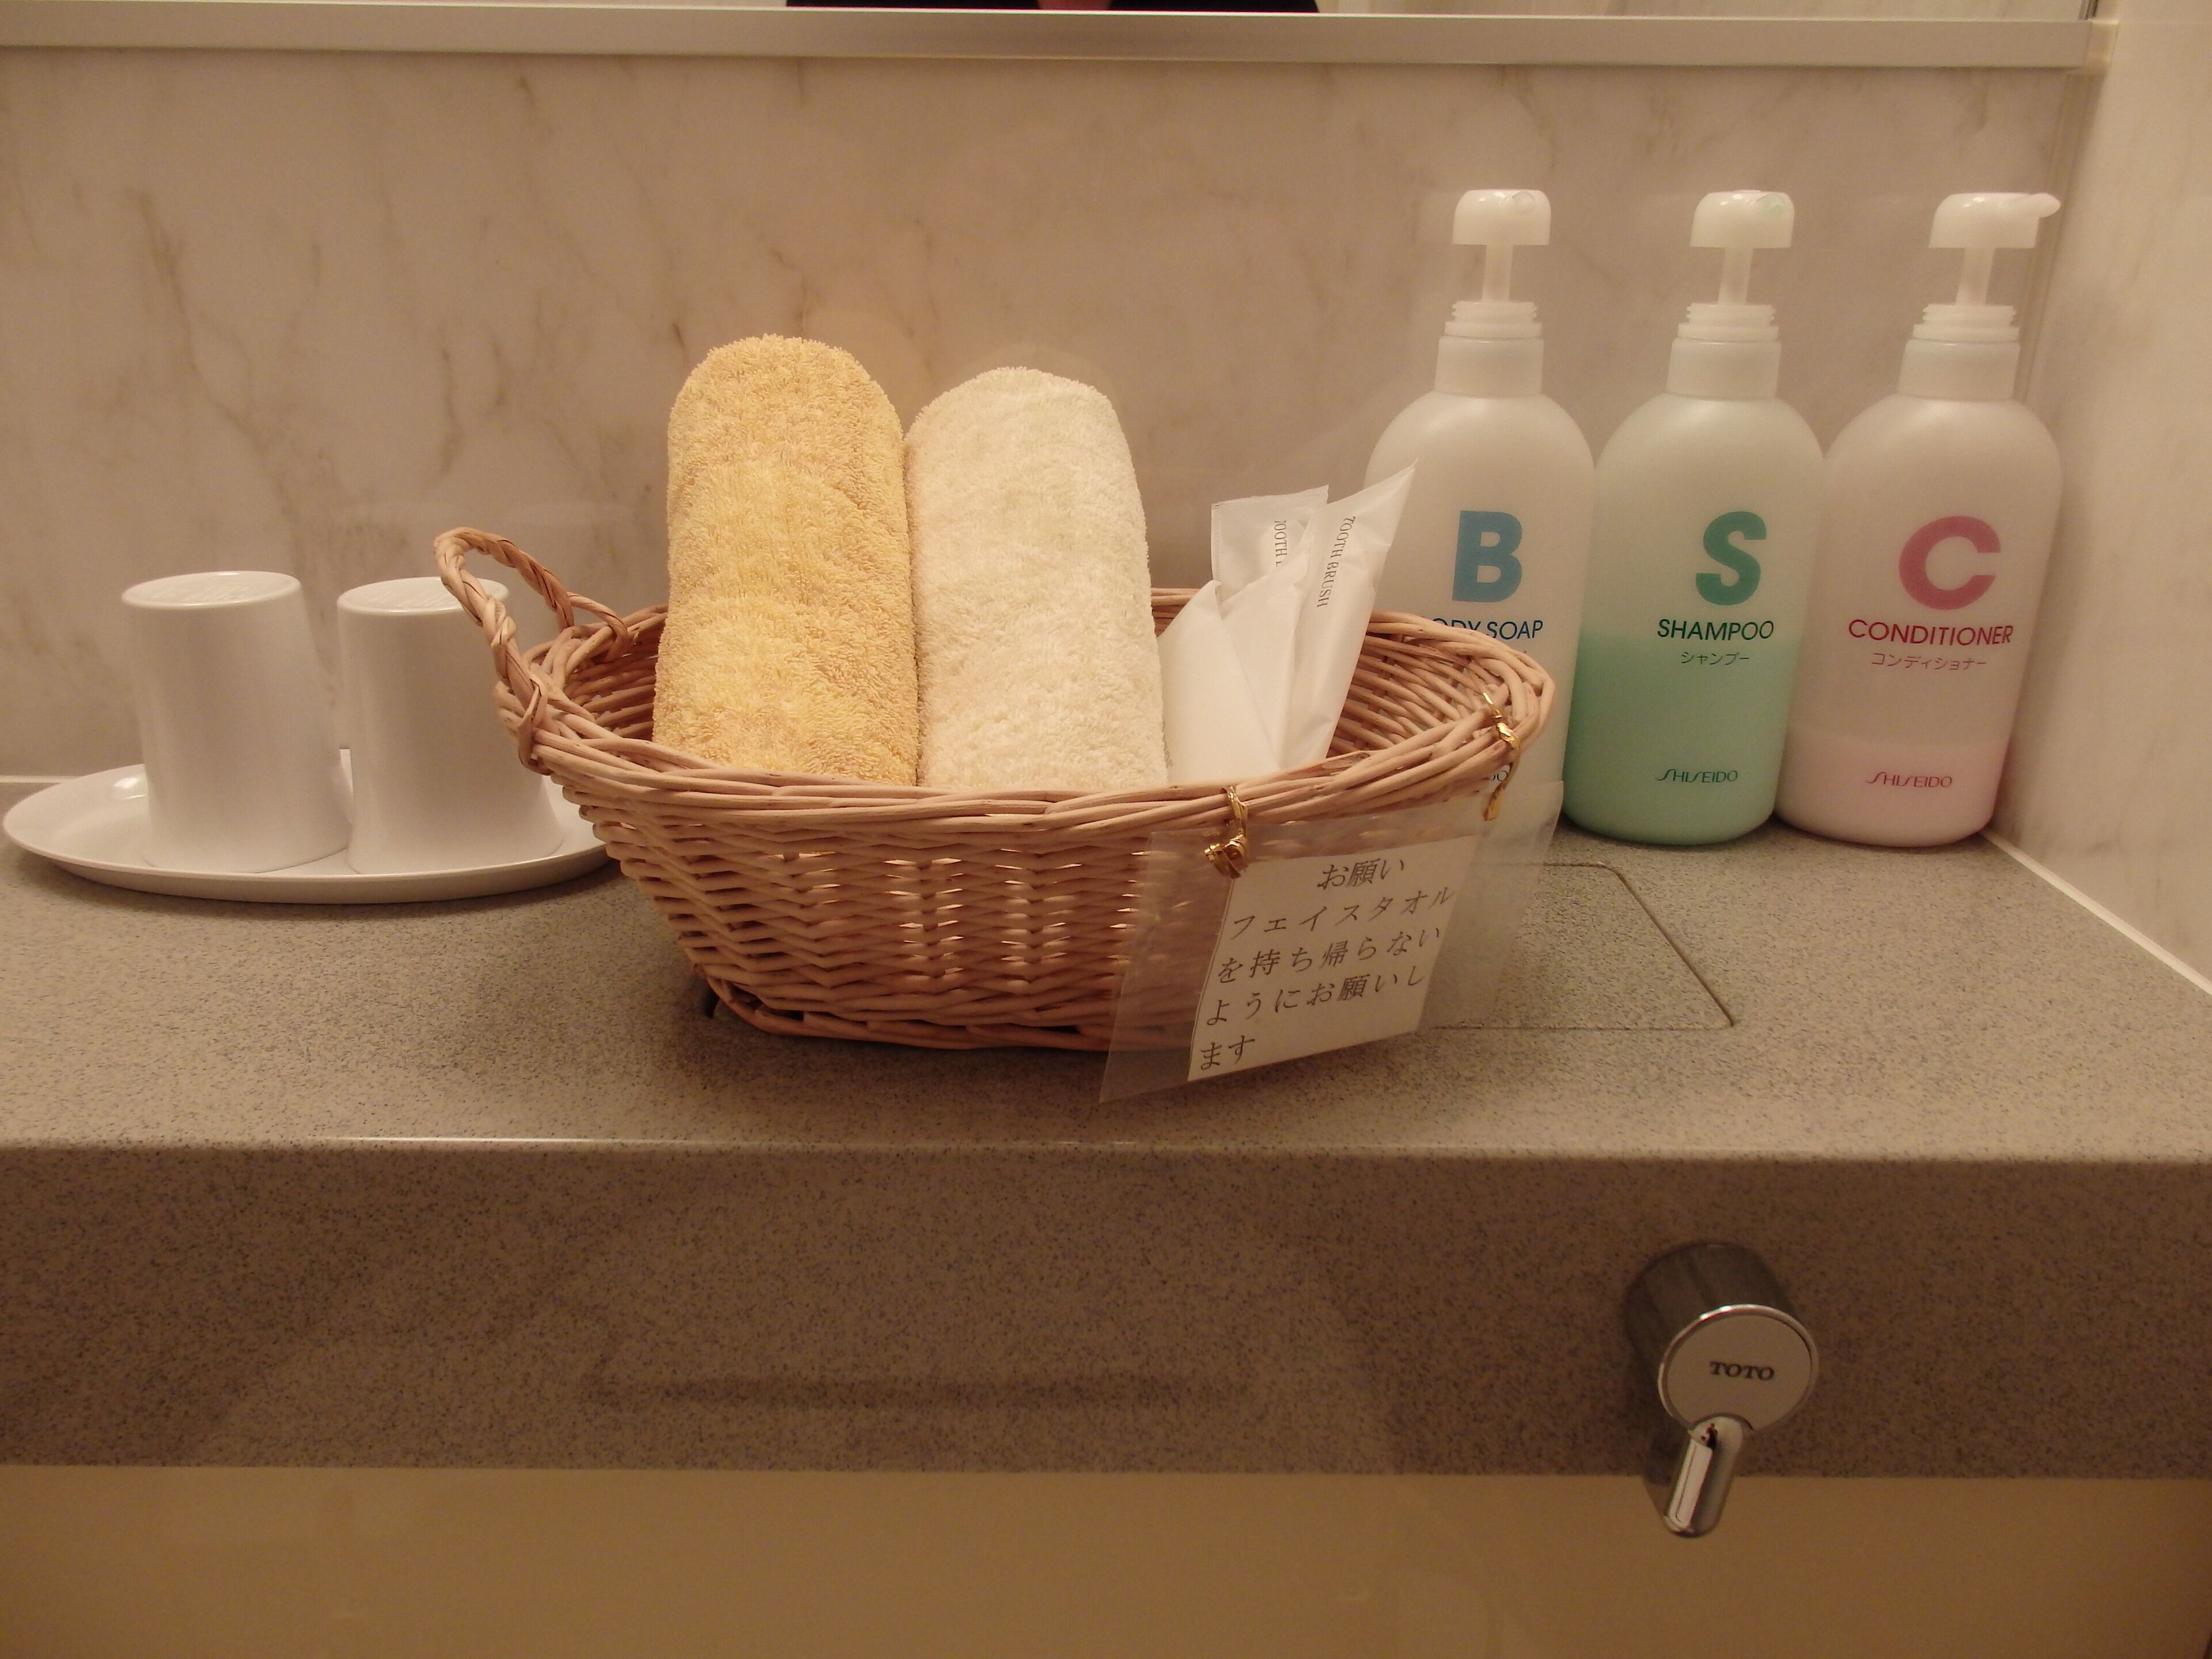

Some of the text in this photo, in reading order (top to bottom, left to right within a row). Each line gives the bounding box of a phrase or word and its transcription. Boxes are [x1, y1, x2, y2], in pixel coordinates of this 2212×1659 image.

[1317, 516, 1355, 608] TOOTH BRUSH
[1452, 510, 1522, 603] B
[1695, 511, 1767, 606] S
[1899, 516, 2001, 611] C
[1486, 620, 1544, 640] SOAP
[1657, 618, 1775, 641] SHAMPOO
[1848, 619, 2014, 646] CONDITIONER
[1680, 651, 1750, 666] シャンプー
[1871, 653, 1987, 671] コンディショナー
[1656, 768, 1738, 783] SHISEIDO
[1866, 771, 1953, 788] SHISEIDO
[1317, 858, 1404, 889] お願い
[1229, 887, 1456, 941] フェイスタオル
[1217, 927, 1440, 984] を持ち帰らない
[1206, 965, 1425, 1026] ようにお願いし
[1199, 1035, 1256, 1070] ます
[1709, 1360, 1775, 1381] TOTO
